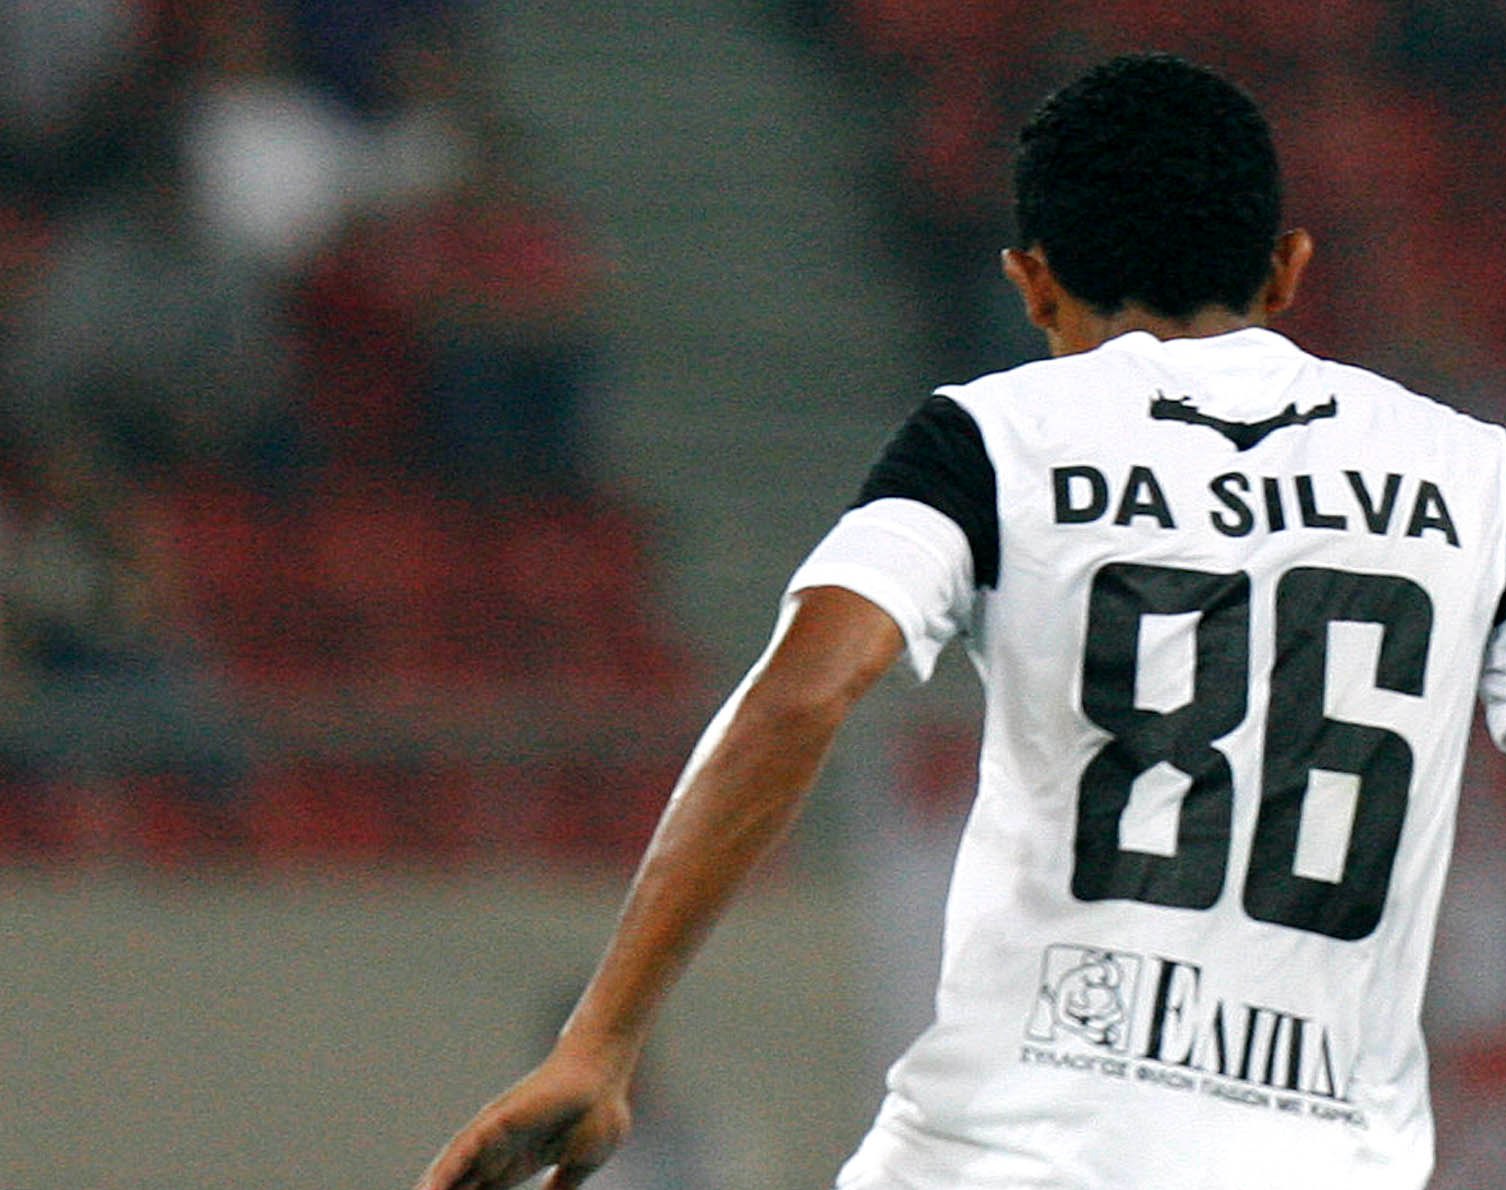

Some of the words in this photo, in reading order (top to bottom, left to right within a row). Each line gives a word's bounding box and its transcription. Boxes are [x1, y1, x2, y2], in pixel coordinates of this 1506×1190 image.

[1050, 465, 1176, 529] DA
[1209, 470, 1462, 548] SILVA
[1070, 562, 1434, 942] 86
